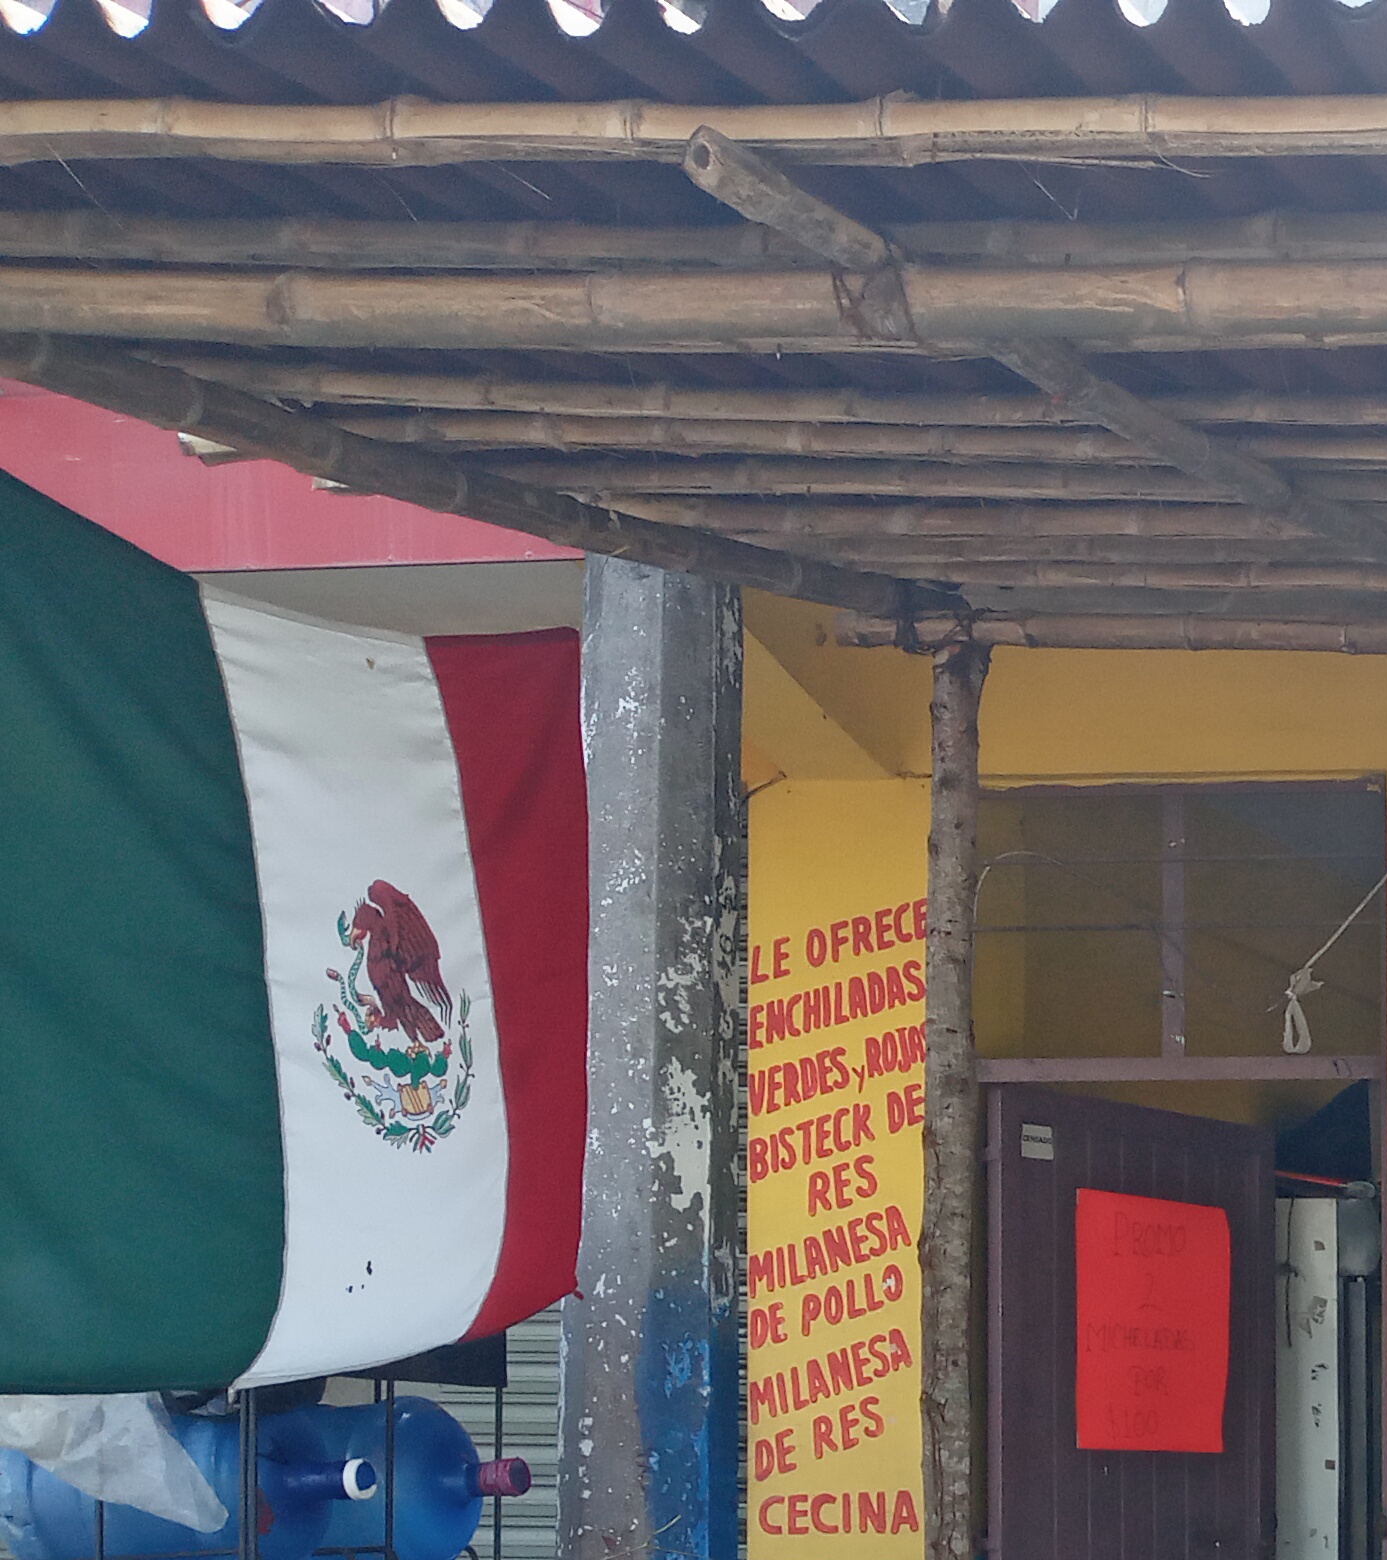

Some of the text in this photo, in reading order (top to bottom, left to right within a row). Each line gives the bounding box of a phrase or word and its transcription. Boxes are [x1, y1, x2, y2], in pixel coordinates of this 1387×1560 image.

[751, 898, 927, 985] LE OFRECE
[749, 960, 926, 1050] ENCHILADAS
[749, 1046, 850, 1116] VERDES
[750, 1083, 926, 1183] BISTECK DE
[808, 1155, 877, 1217] RES
[750, 1205, 912, 1299] MILANESA
[750, 1264, 904, 1350] DE POLLO
[750, 1328, 913, 1425] MILANESA
[755, 1396, 885, 1482] DE RES
[758, 1490, 919, 1535] CECINA
